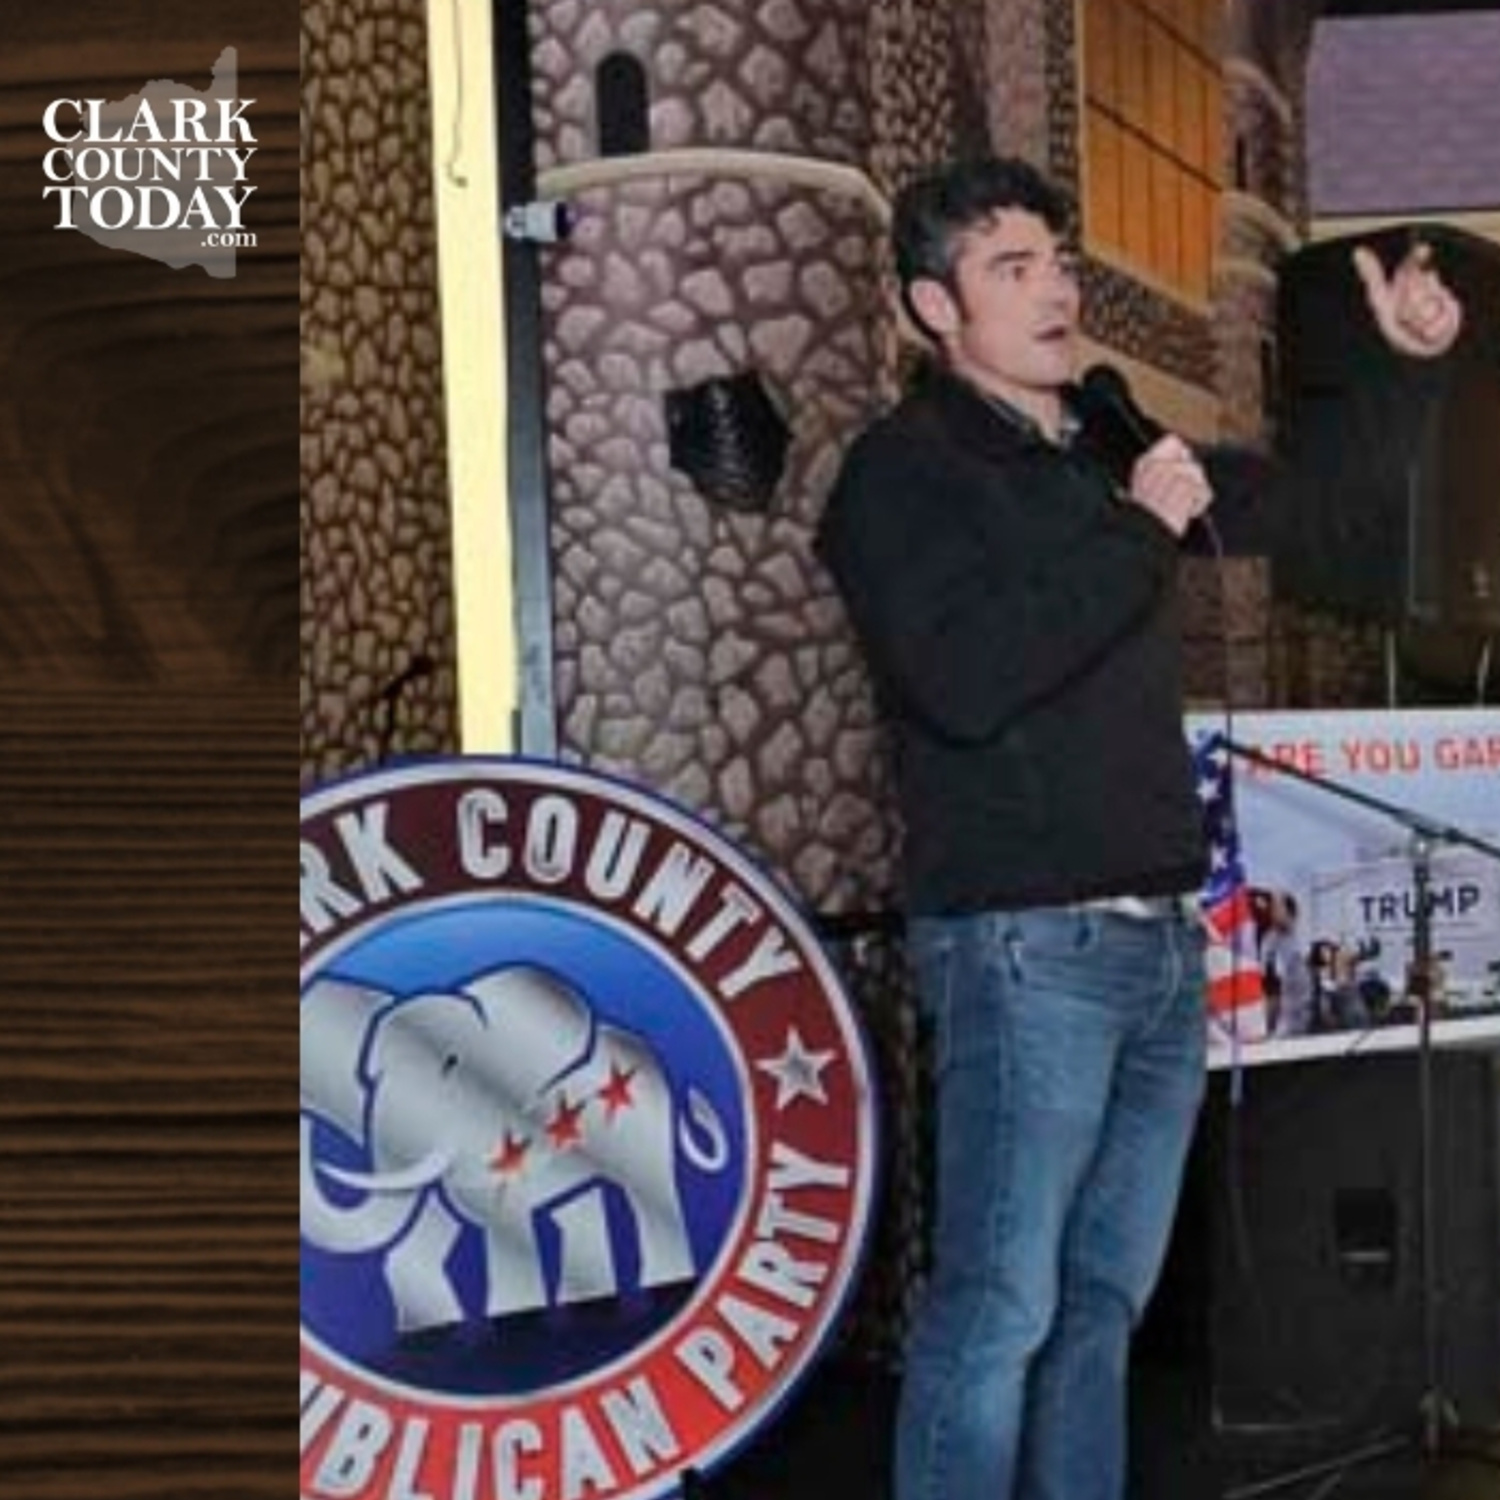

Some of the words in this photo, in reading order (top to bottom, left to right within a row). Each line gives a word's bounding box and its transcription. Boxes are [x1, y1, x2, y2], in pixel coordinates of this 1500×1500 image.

[1340, 737, 1421, 772] YOU
[300, 801, 425, 946] RK
[456, 787, 802, 1000] COUNTY
[1359, 885, 1481, 922] TRUMP
[674, 1142, 850, 1412] PARTY
